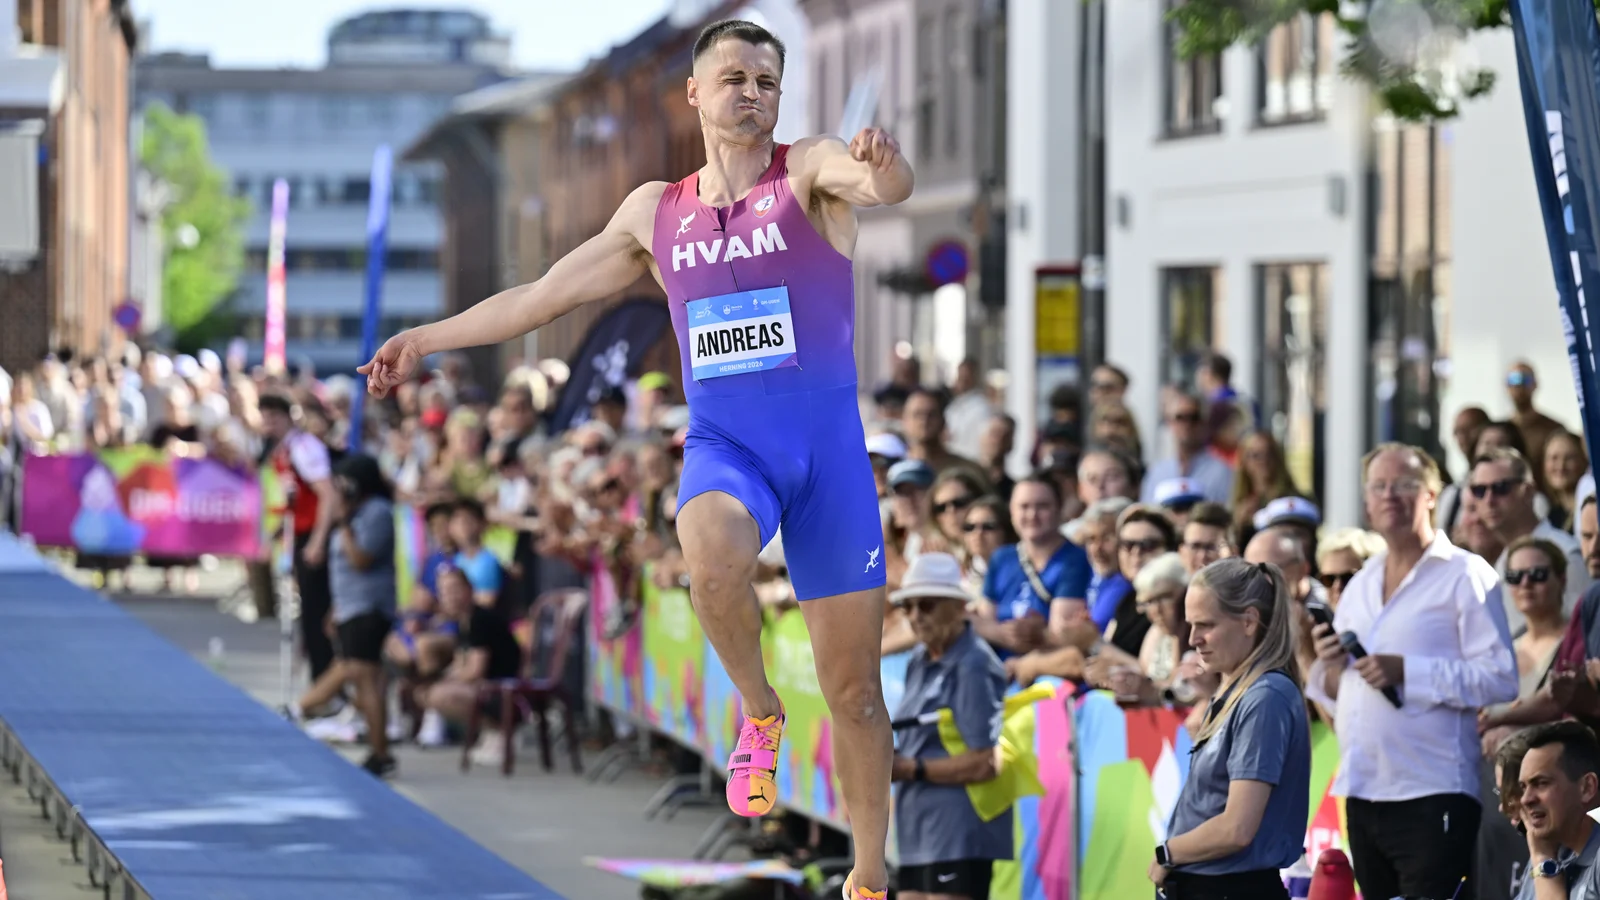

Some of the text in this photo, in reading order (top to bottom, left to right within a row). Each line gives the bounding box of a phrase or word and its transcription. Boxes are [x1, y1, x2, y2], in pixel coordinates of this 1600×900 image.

[672, 222, 788, 272] HVAM
[697, 322, 784, 358] ANDREAS
[719, 360, 764, 372] HERNING 2026
[733, 754, 752, 764] PUMA
